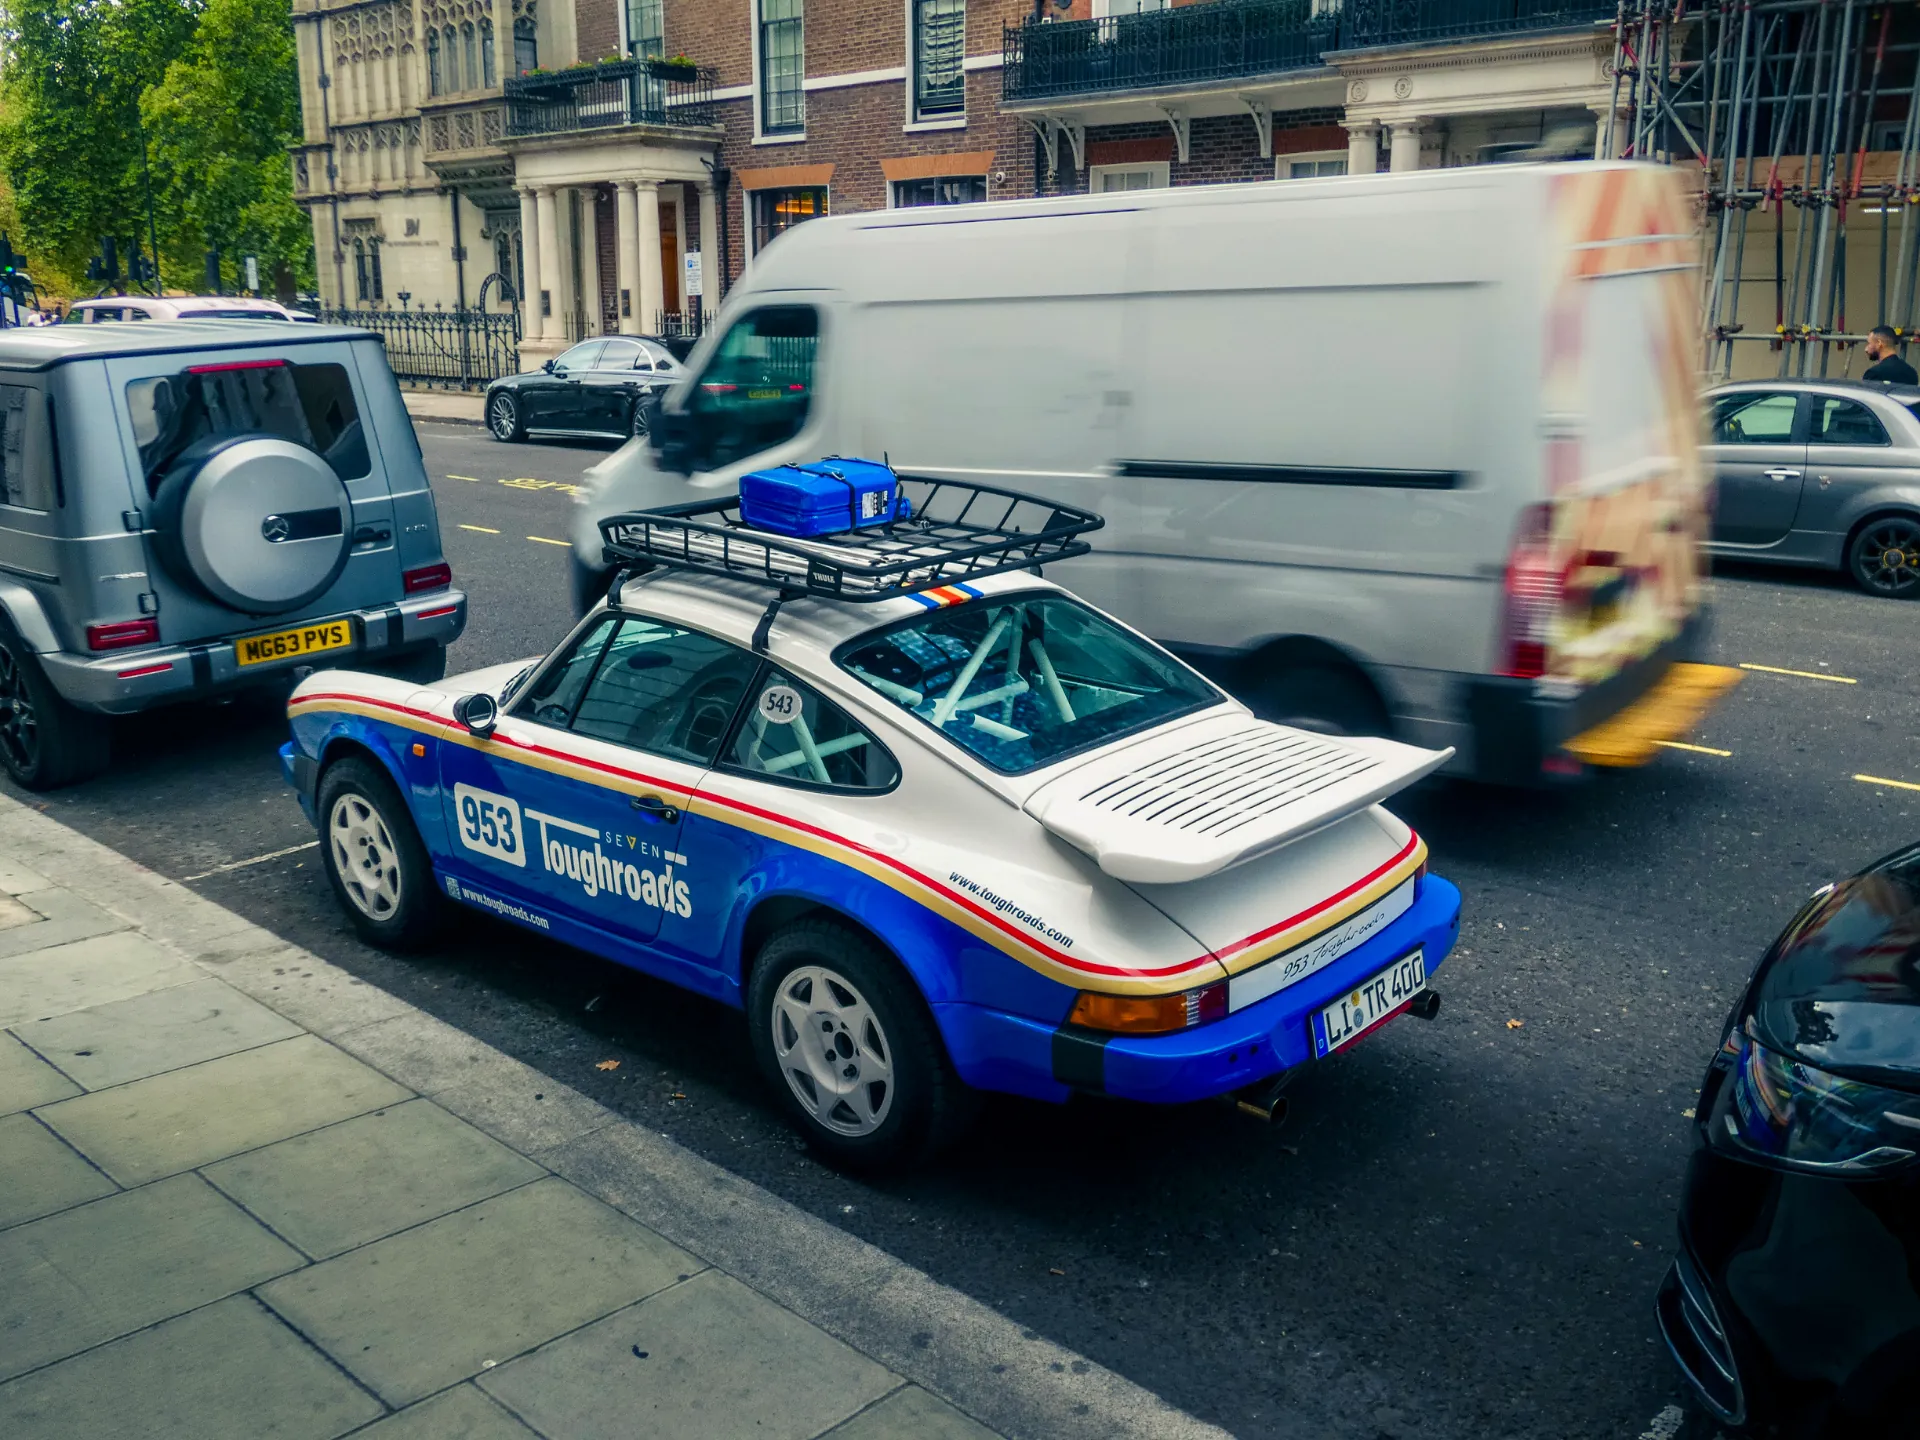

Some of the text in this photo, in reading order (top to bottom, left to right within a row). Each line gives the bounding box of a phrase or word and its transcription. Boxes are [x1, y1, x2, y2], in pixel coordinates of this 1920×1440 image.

[812, 571, 836, 584] THULE
[245, 625, 343, 661] MG63 PVS
[766, 692, 794, 714] 543
[462, 795, 517, 854] 953
[605, 831, 660, 859] SEVEN
[525, 807, 692, 919] Toughroads
[461, 887, 550, 930] www.toughroads.com
[948, 871, 1074, 949] www.toughroads.com
[1282, 911, 1385, 982] 953 Toughroads
[1325, 955, 1424, 1046] LI TR 400
